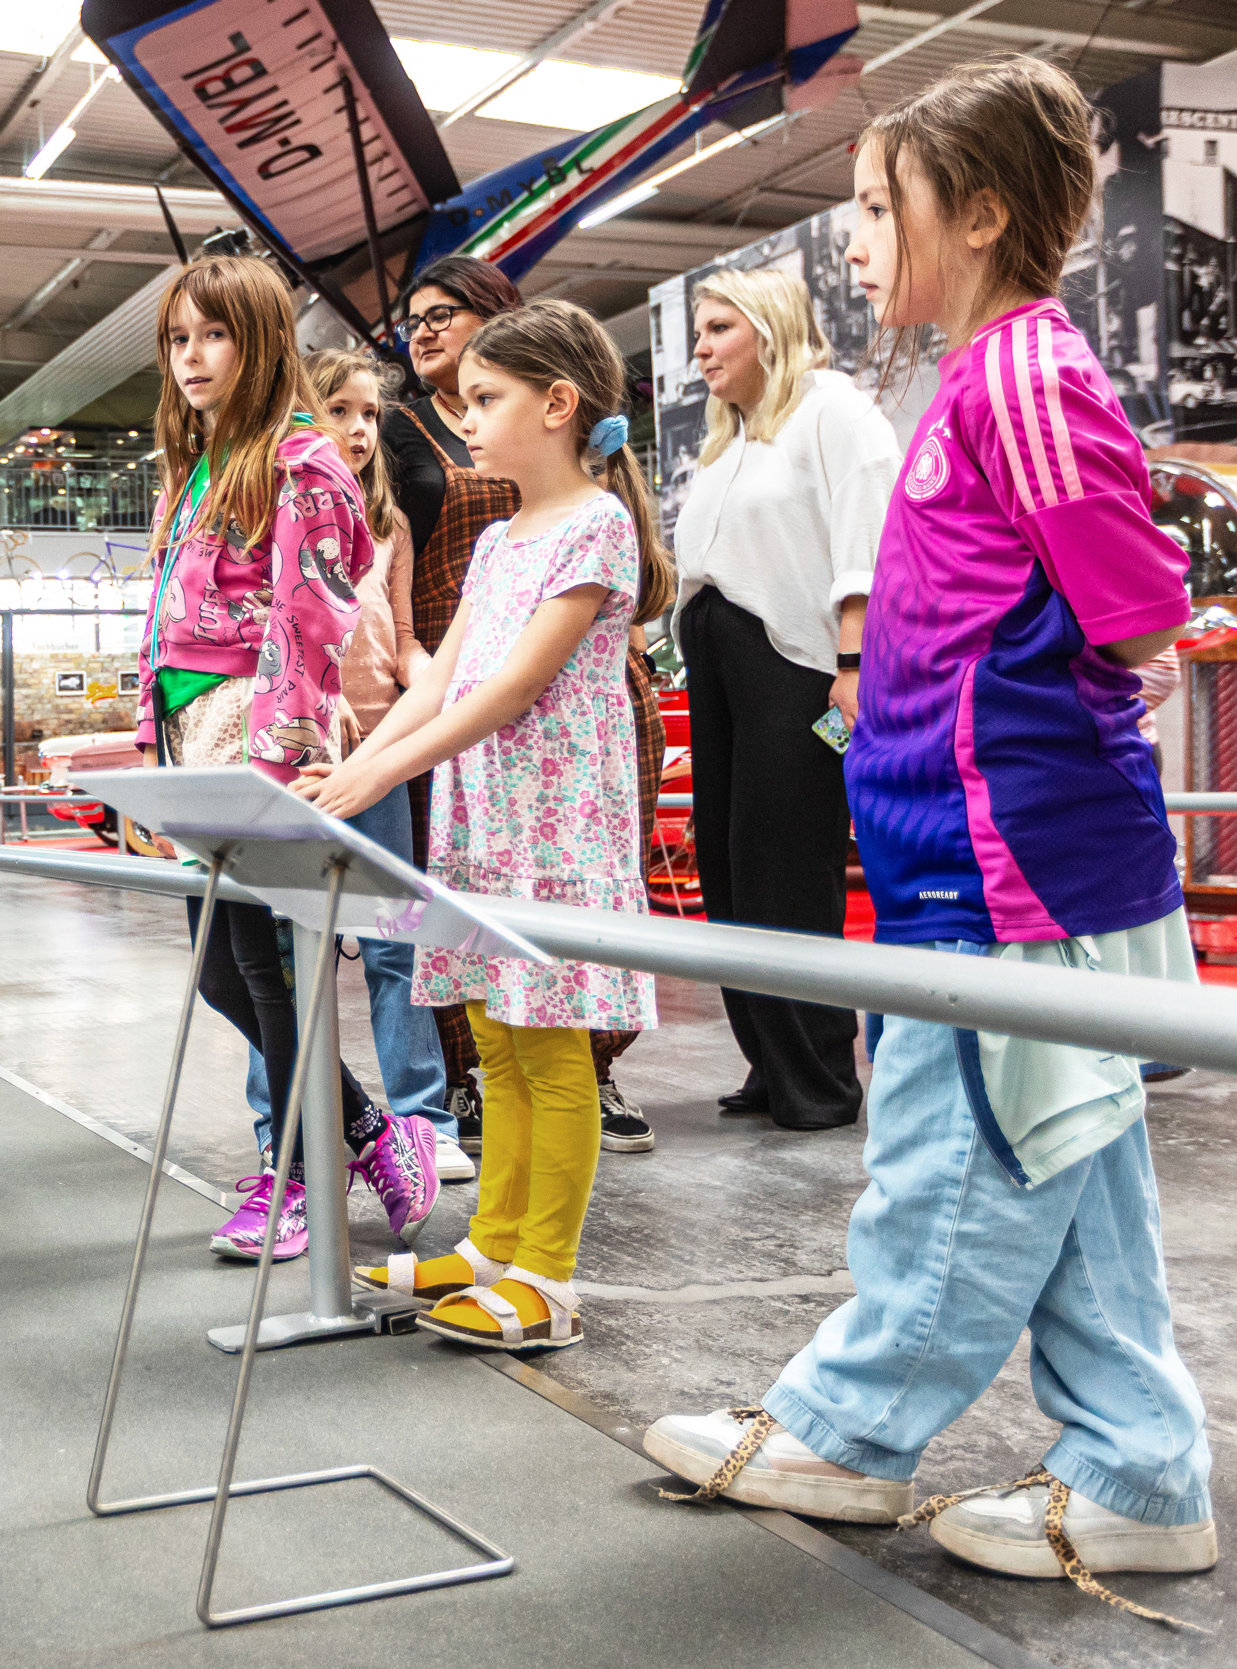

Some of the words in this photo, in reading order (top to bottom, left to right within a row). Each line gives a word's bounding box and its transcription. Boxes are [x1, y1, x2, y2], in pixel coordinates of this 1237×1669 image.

[181, 31, 323, 181] D-MYBL
[286, 615, 306, 677] SWEETEST
[277, 680, 296, 703] PAIR
